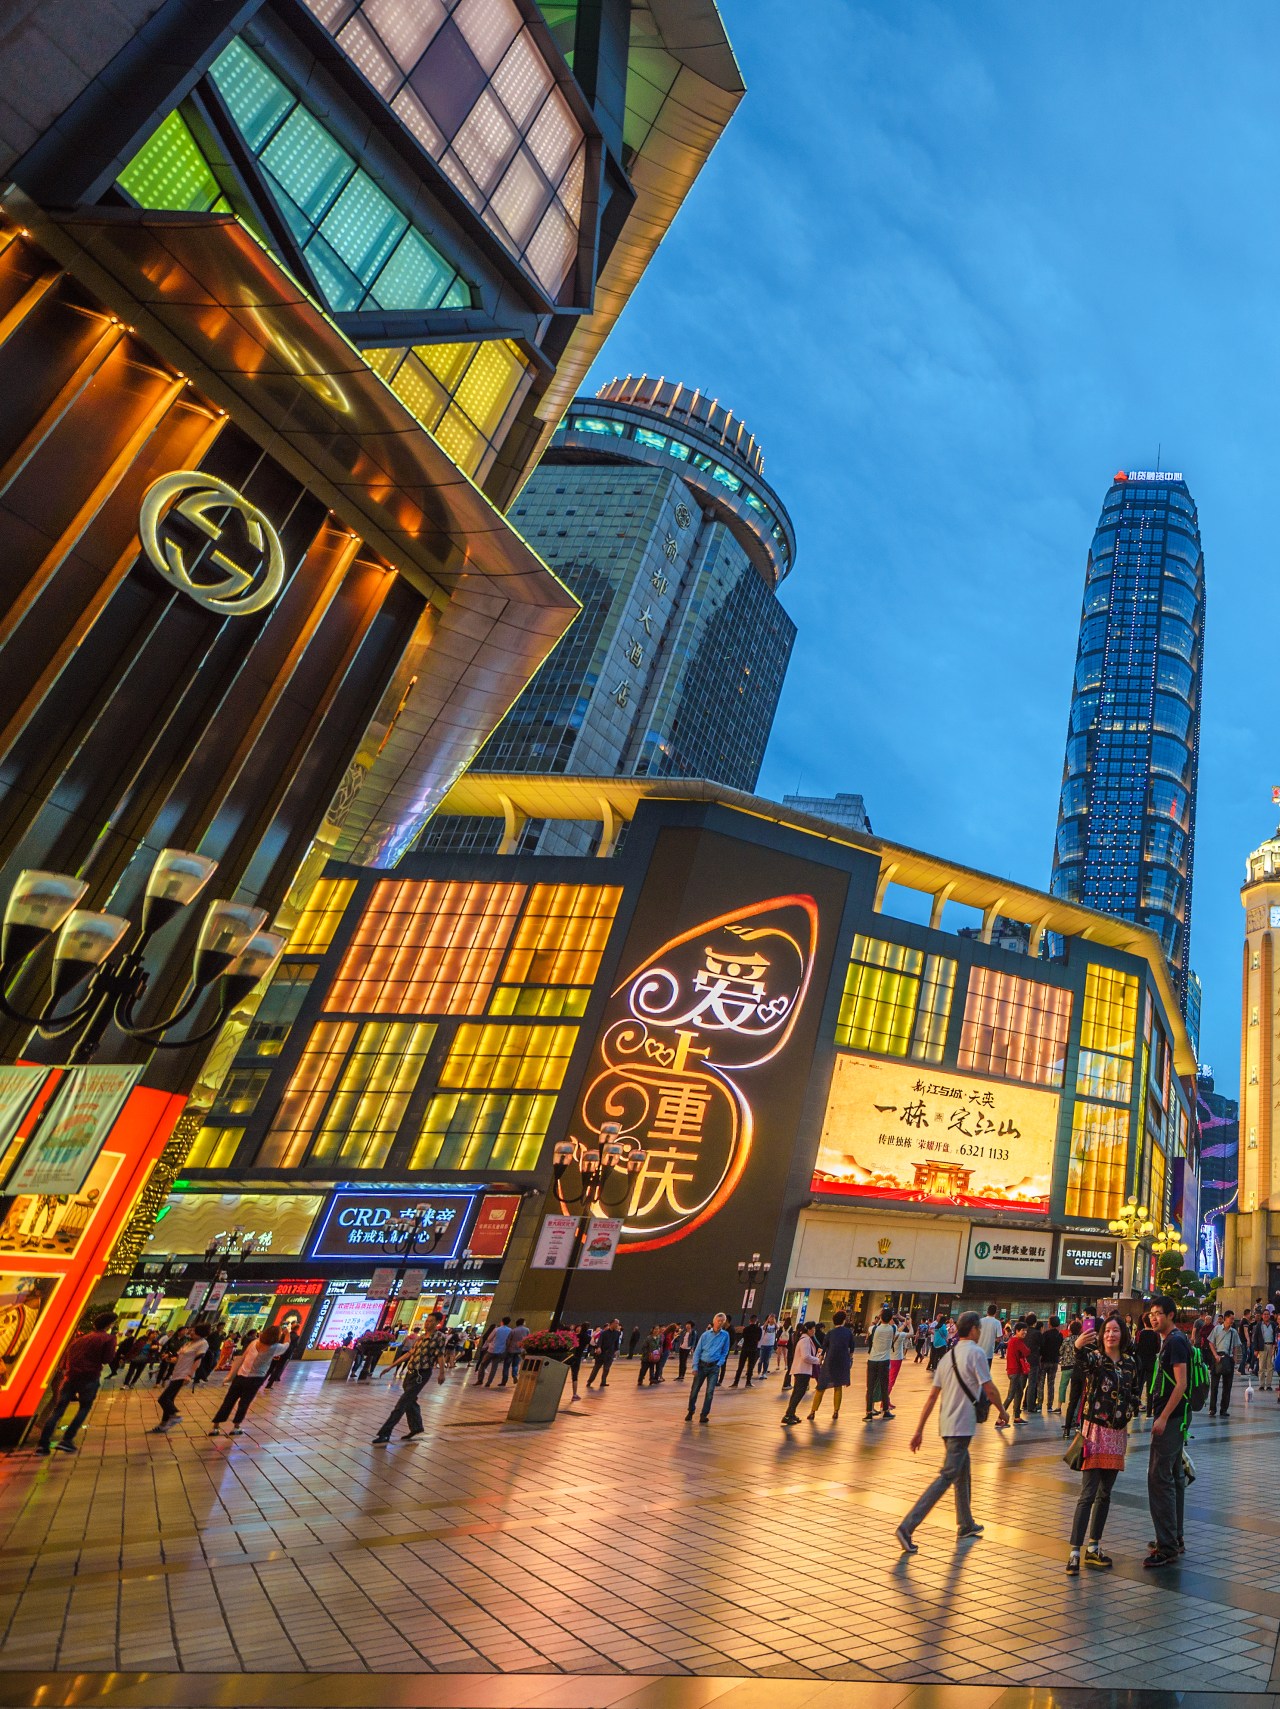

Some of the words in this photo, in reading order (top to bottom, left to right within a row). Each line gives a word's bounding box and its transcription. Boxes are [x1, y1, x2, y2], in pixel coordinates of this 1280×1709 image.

[610, 533, 679, 709] 渝都大酒店
[628, 946, 771, 1217] 爱上重庆
[959, 1143, 984, 1158] 6321
[988, 1145, 1009, 1161] 1133
[338, 1208, 391, 1227] CRD
[348, 1229, 430, 1244] 钻戒定制心
[993, 1243, 1046, 1257] 中国农业银行
[1066, 1249, 1112, 1260] STARBUCKS
[856, 1256, 905, 1270] ROLEX
[1074, 1258, 1103, 1267] COFFEE
